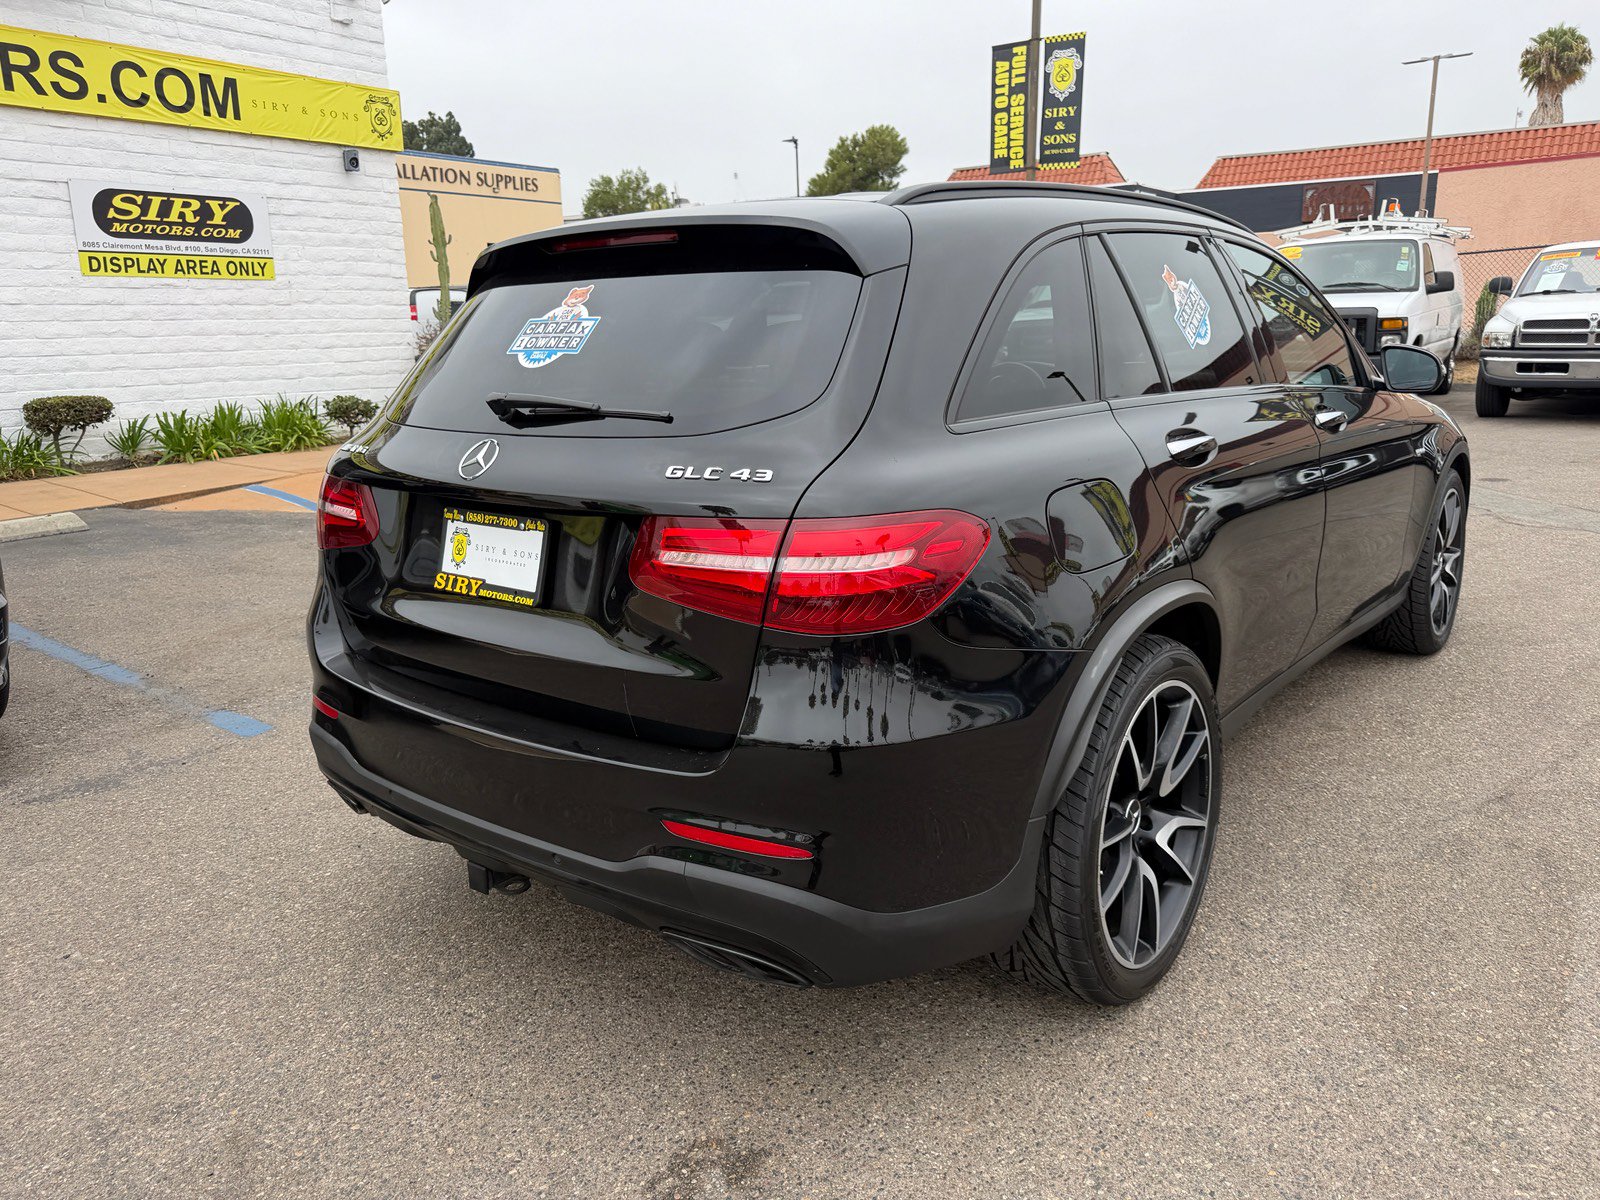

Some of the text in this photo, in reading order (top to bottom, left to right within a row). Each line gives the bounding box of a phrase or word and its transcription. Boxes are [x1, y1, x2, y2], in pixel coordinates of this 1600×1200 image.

[251, 100, 360, 122] SIRY & SONS
[993, 61, 1010, 159] AUTO CARE
[1009, 45, 1027, 169] FULL SERVICE
[1044, 106, 1077, 119] SIRY
[1054, 121, 1066, 131] &
[1043, 133, 1077, 146] SONS
[476, 171, 540, 193] SUPPLIES
[107, 193, 240, 224] SIRY
[110, 222, 242, 239] MOTORS.COM
[82, 241, 100, 249] 8085
[102, 241, 143, 251] Clairemont
[144, 243, 164, 251] Mesa
[165, 244, 184, 253] Blvd,
[218, 247, 240, 255] Diego,
[87, 255, 267, 277] DISPLAY AREA ONLY
[525, 321, 589, 335] CARFAX
[516, 337, 581, 348] 1 OWNER
[665, 465, 774, 483] GLC 43
[466, 512, 484, 524] (858)
[484, 515, 518, 528] 277-7300
[475, 544, 496, 554] SIRY
[513, 550, 539, 561] SONS
[434, 573, 534, 606] SIRY MOTORS.COM
